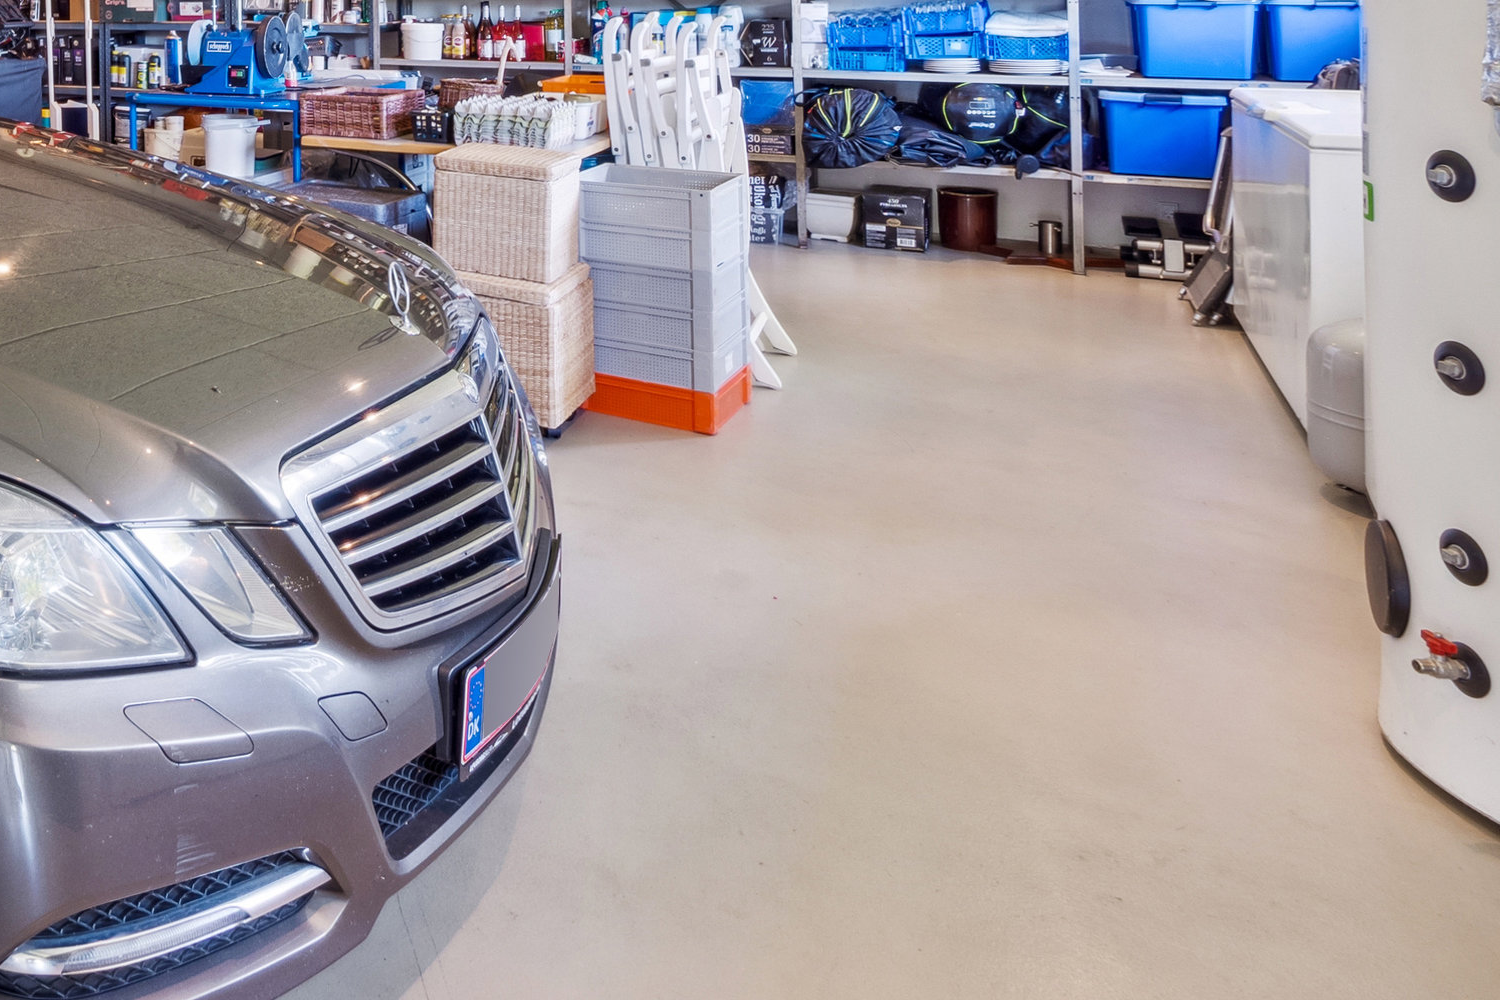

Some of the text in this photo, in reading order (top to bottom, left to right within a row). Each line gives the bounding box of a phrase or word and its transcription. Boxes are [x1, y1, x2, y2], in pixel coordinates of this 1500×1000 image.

[761, 23, 775, 31] 225
[747, 133, 761, 143] 30
[747, 144, 761, 153] 30
[467, 715, 480, 741] DK
